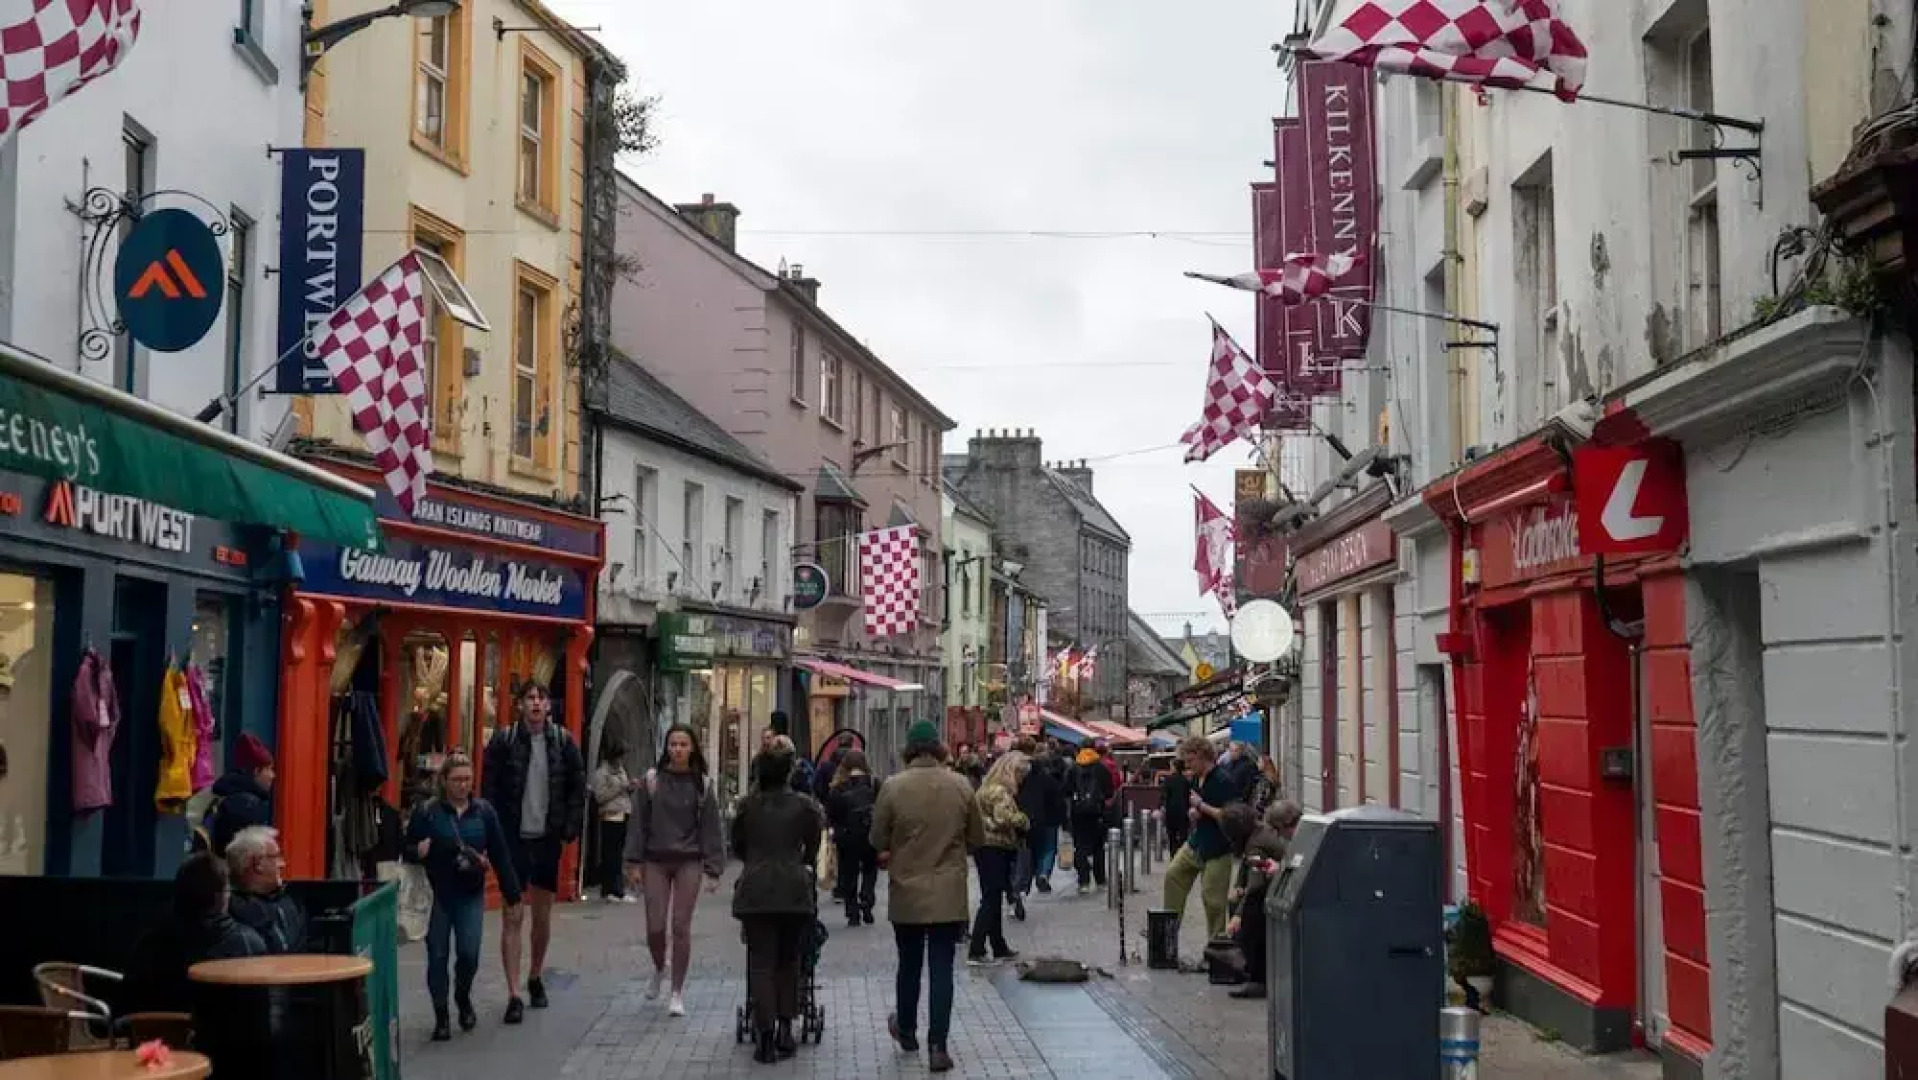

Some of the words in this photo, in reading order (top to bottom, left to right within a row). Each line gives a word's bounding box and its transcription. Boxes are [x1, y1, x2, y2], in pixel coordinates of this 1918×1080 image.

[76, 483, 194, 553] PORTWEST
[413, 500, 444, 523] ARAN
[446, 507, 491, 532] ISLANDS
[492, 515, 542, 541] KNITWEAR
[1508, 500, 1580, 568] Ladbroke
[341, 547, 421, 596] Galway
[426, 551, 500, 597] Woollen
[503, 561, 563, 605] Market
